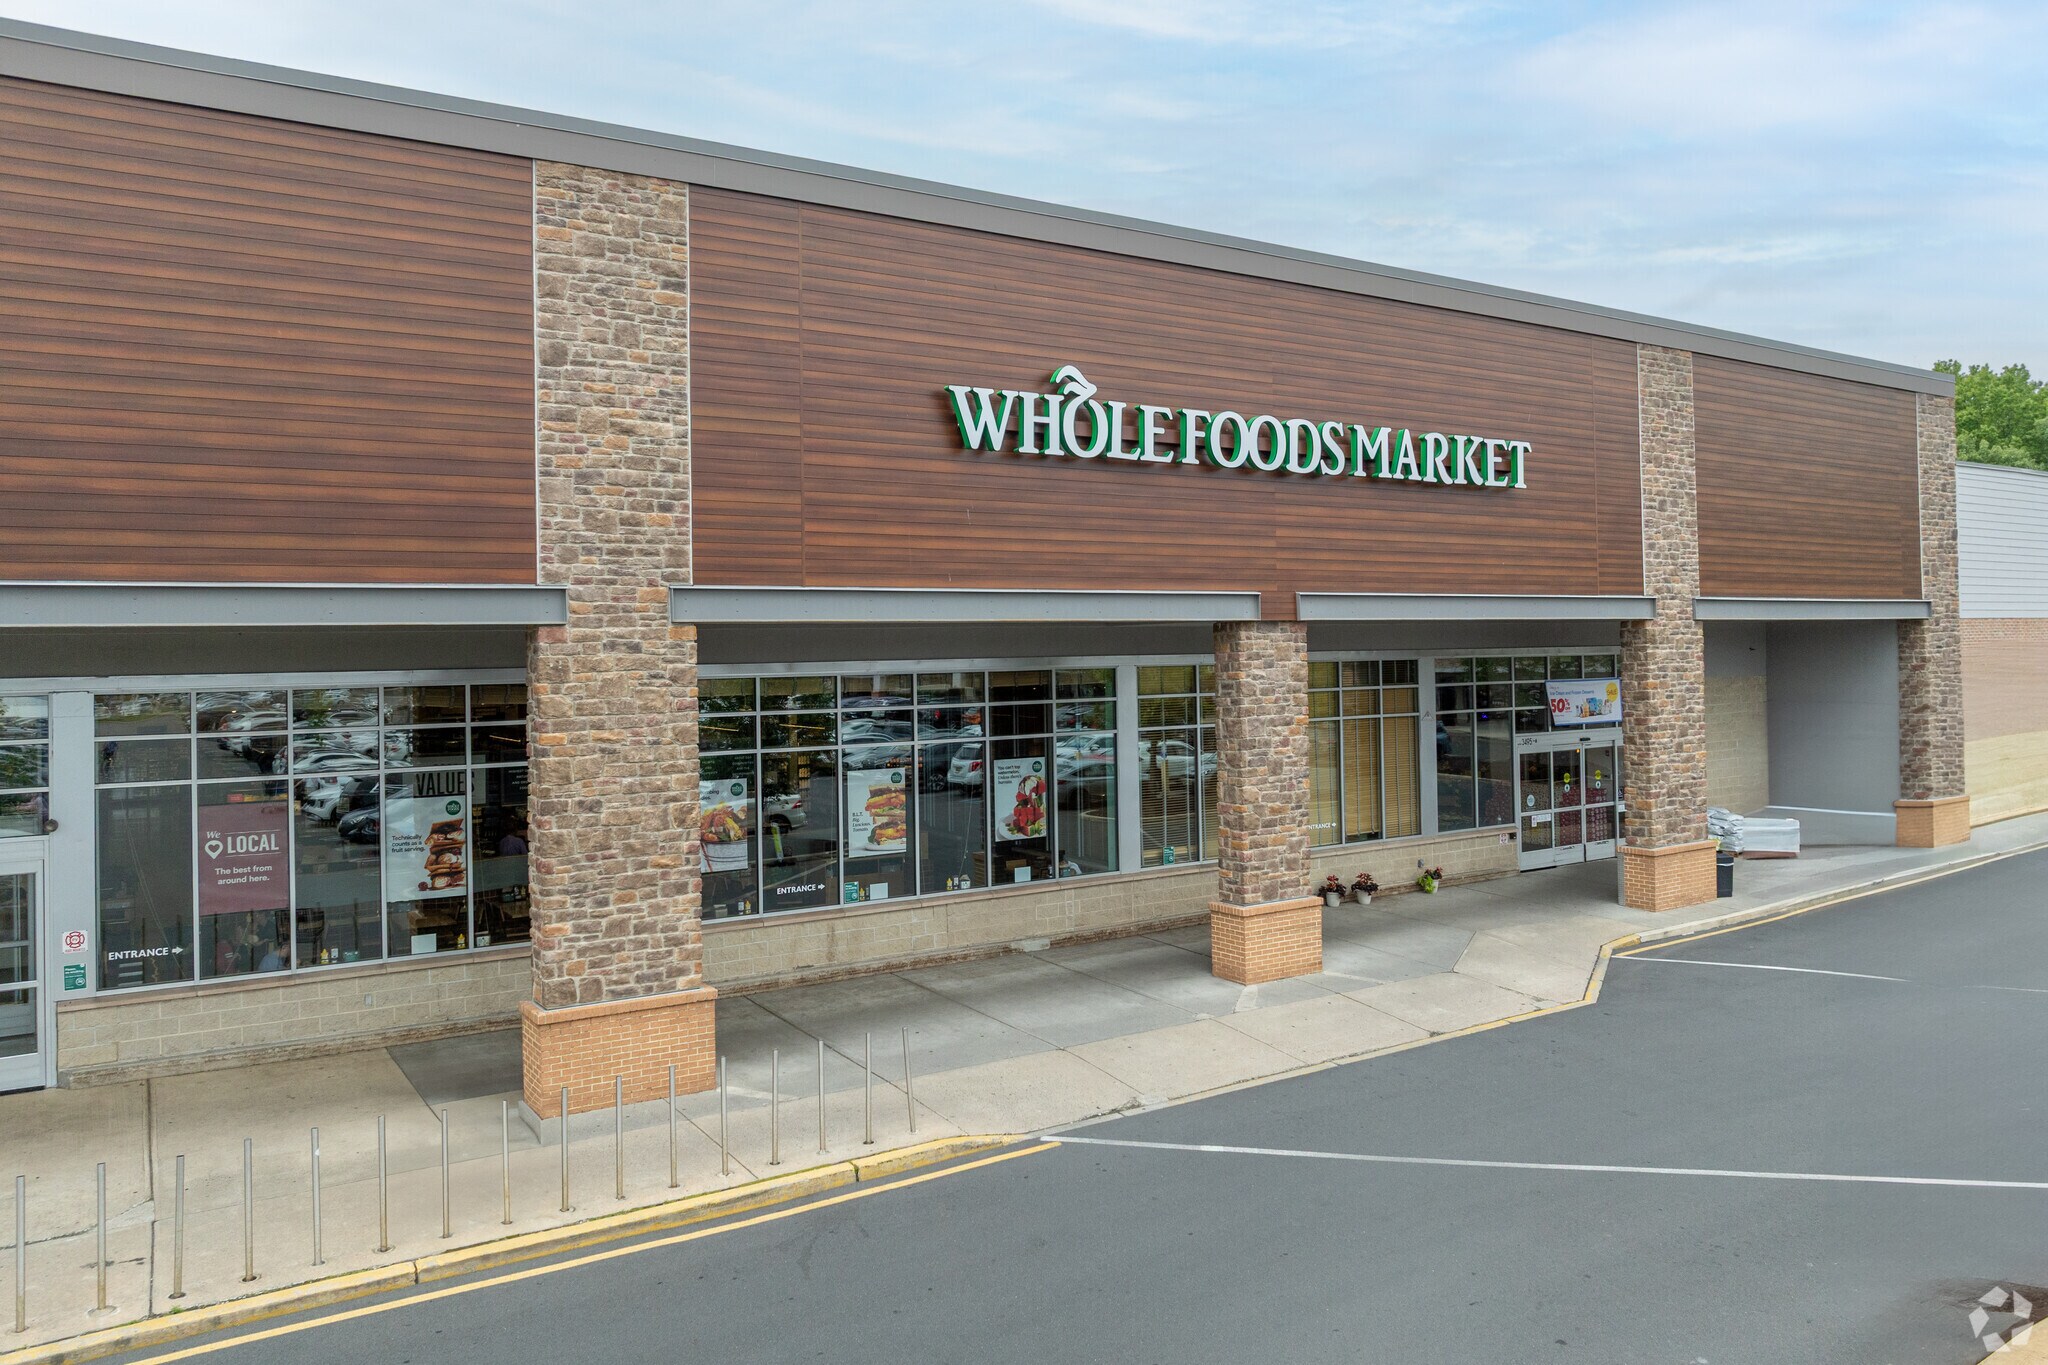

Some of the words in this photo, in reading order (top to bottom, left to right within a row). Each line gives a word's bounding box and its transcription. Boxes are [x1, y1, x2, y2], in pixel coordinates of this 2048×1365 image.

[944, 365, 1173, 463] WHOLE
[1176, 408, 1346, 477] FOODS
[1349, 424, 1532, 489] MARKET
[227, 834, 280, 854] LOCAL
[218, 876, 247, 884] around
[776, 884, 816, 895] ENTRANCE
[108, 947, 169, 961] ENTRANCE
